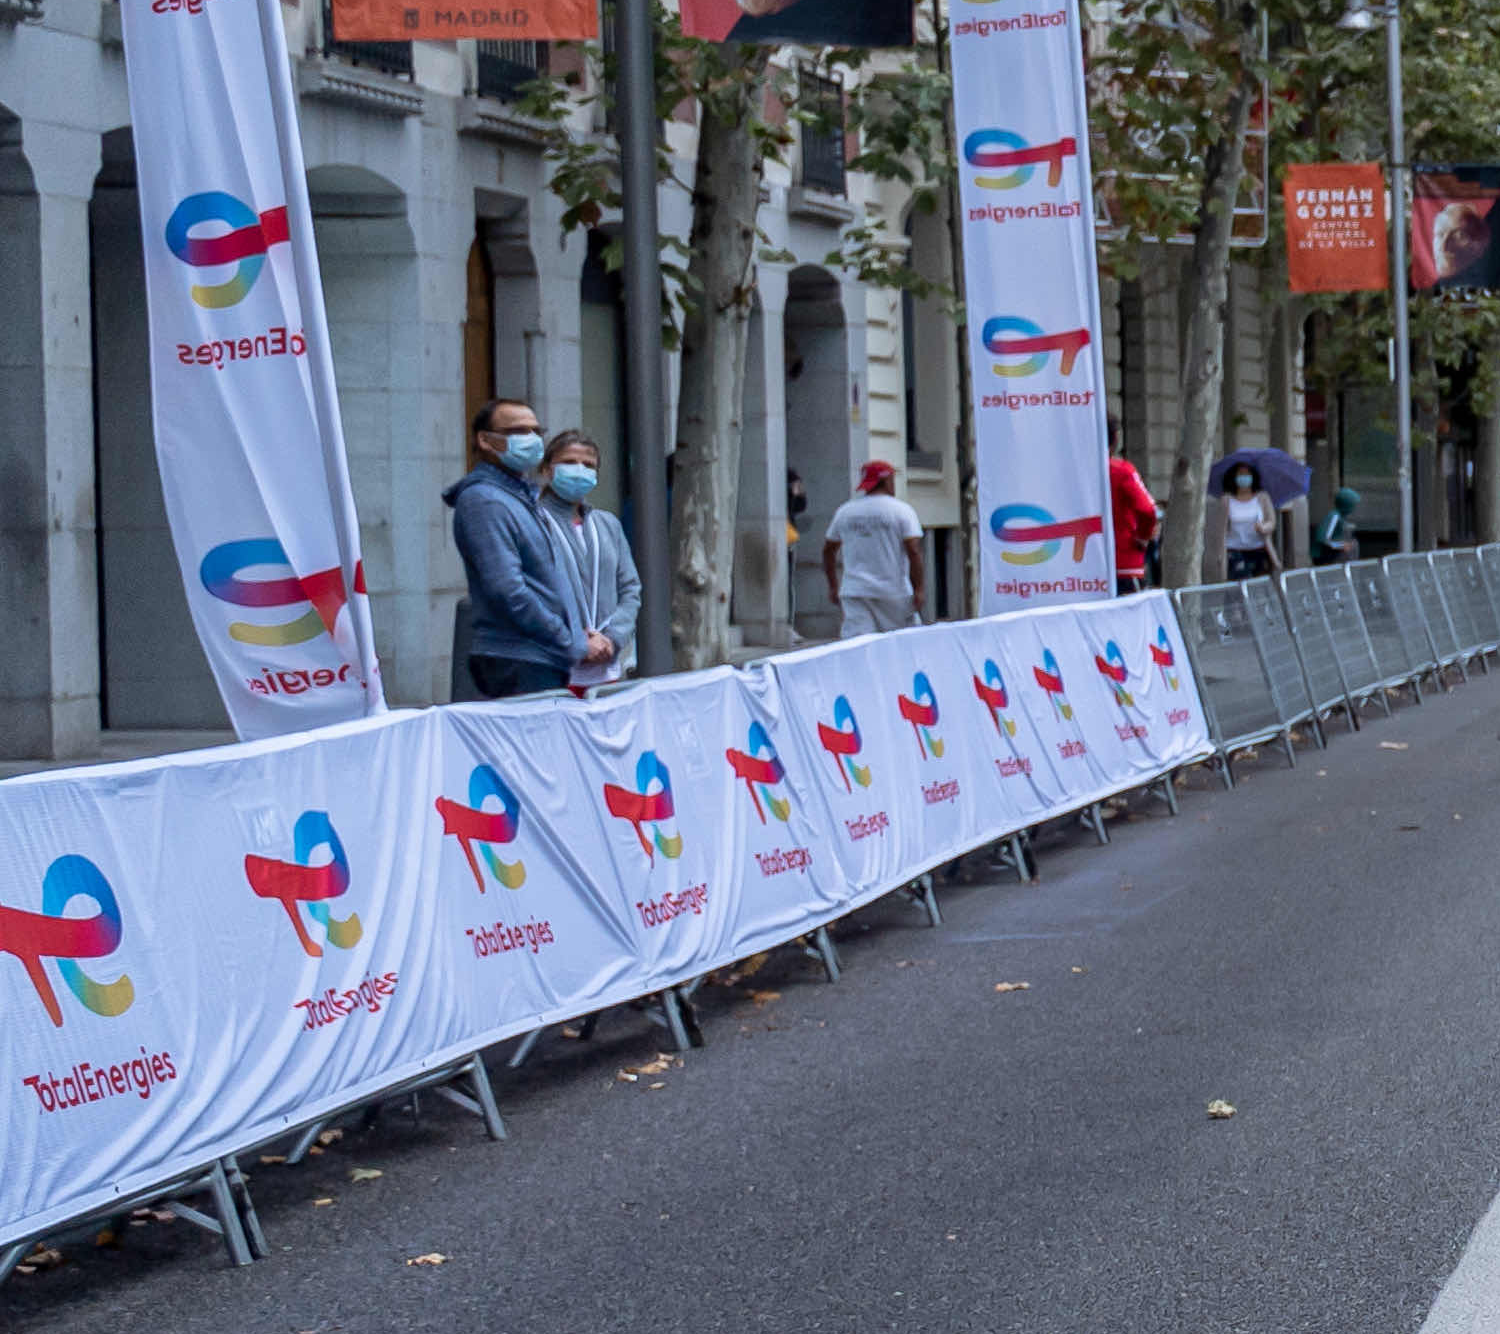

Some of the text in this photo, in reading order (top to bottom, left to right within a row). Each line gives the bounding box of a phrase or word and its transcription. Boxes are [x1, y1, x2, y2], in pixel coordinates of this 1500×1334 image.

[434, 9, 530, 28] MADRID
[1296, 185, 1374, 204] FERNÁN
[1296, 203, 1375, 220] GÓMEZ
